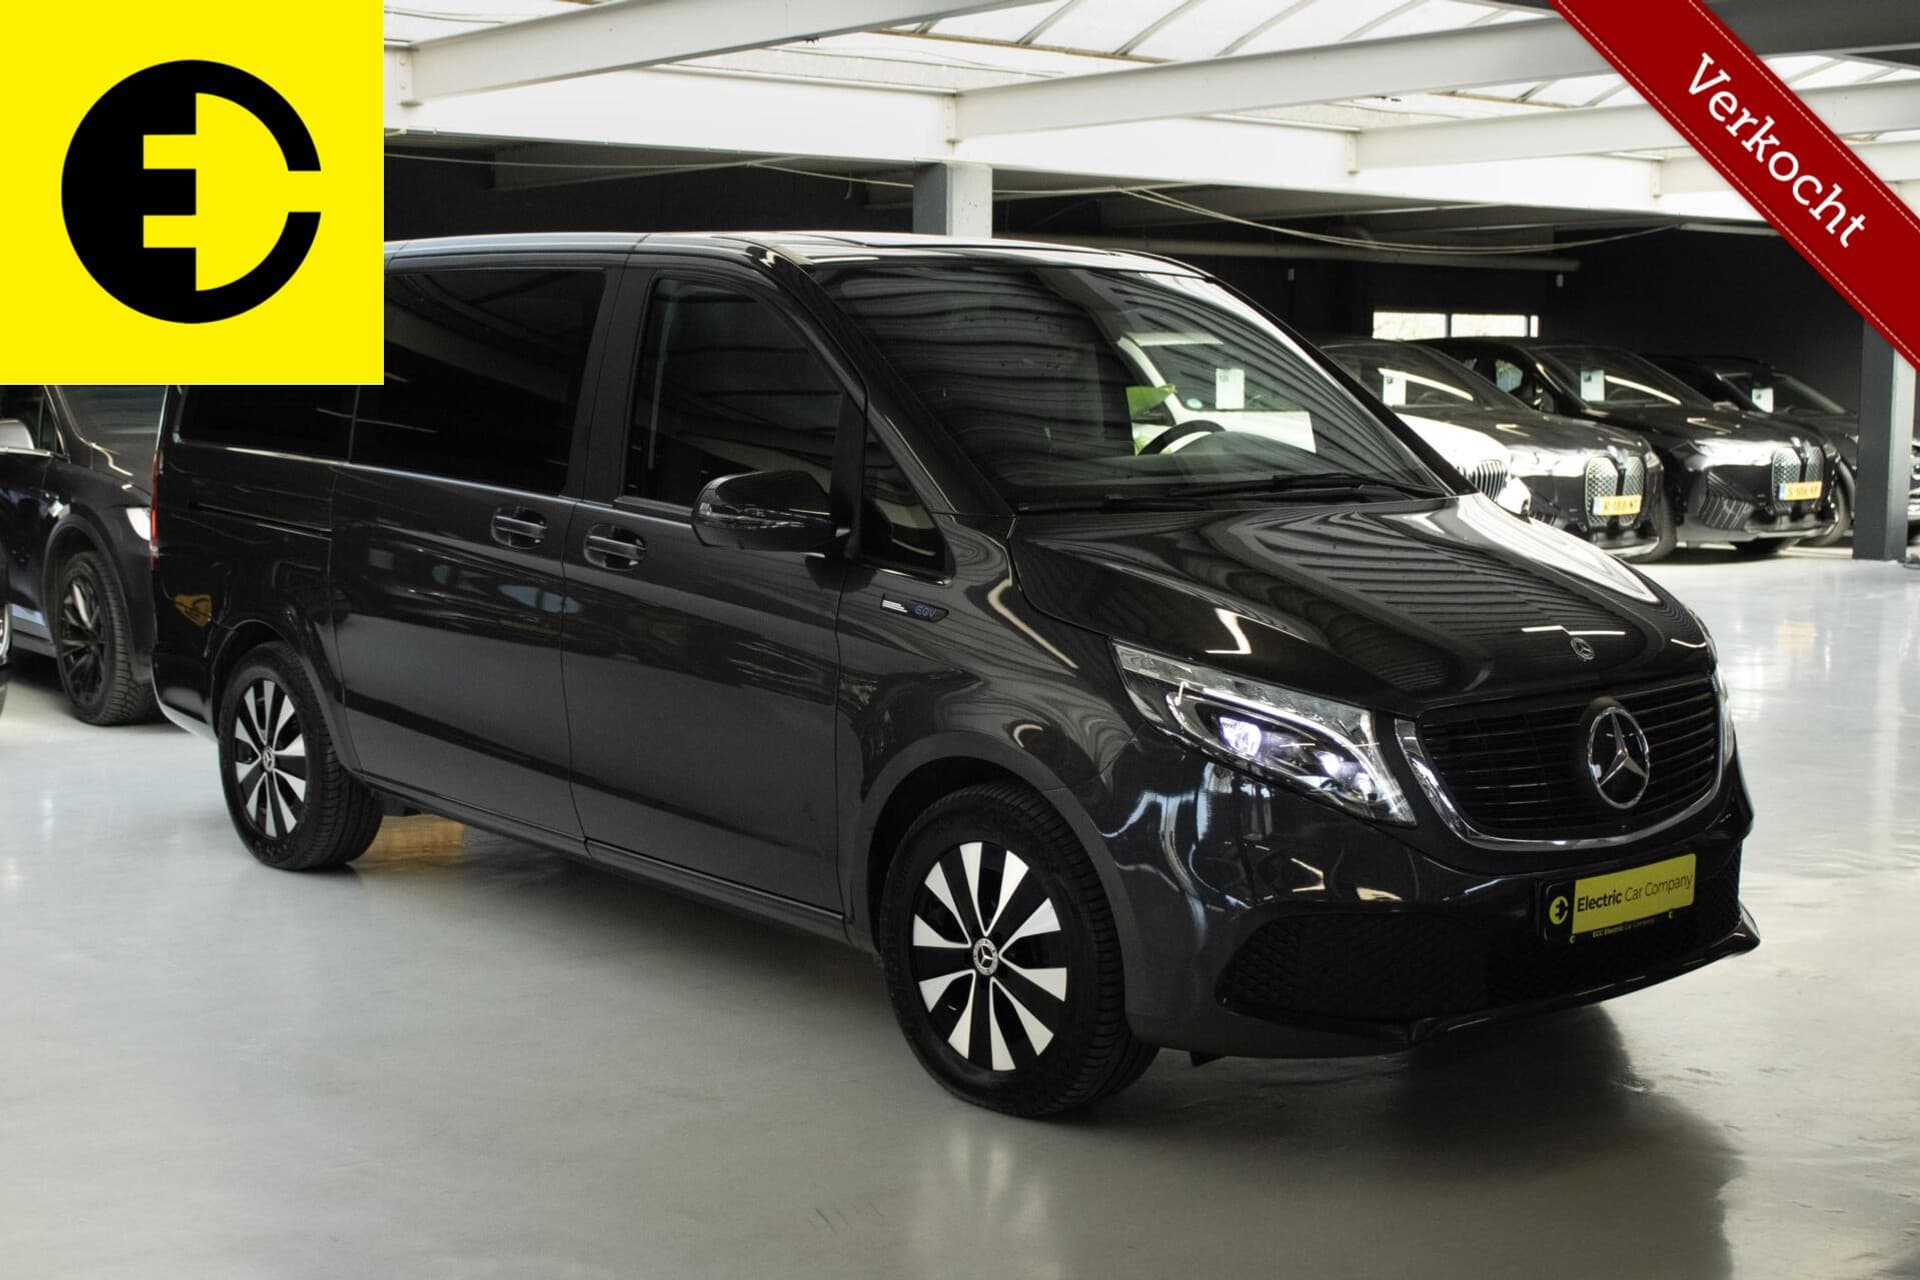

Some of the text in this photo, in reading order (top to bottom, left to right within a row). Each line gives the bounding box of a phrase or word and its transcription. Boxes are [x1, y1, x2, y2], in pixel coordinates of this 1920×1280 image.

[1577, 874, 1693, 912] Electric Car Company
